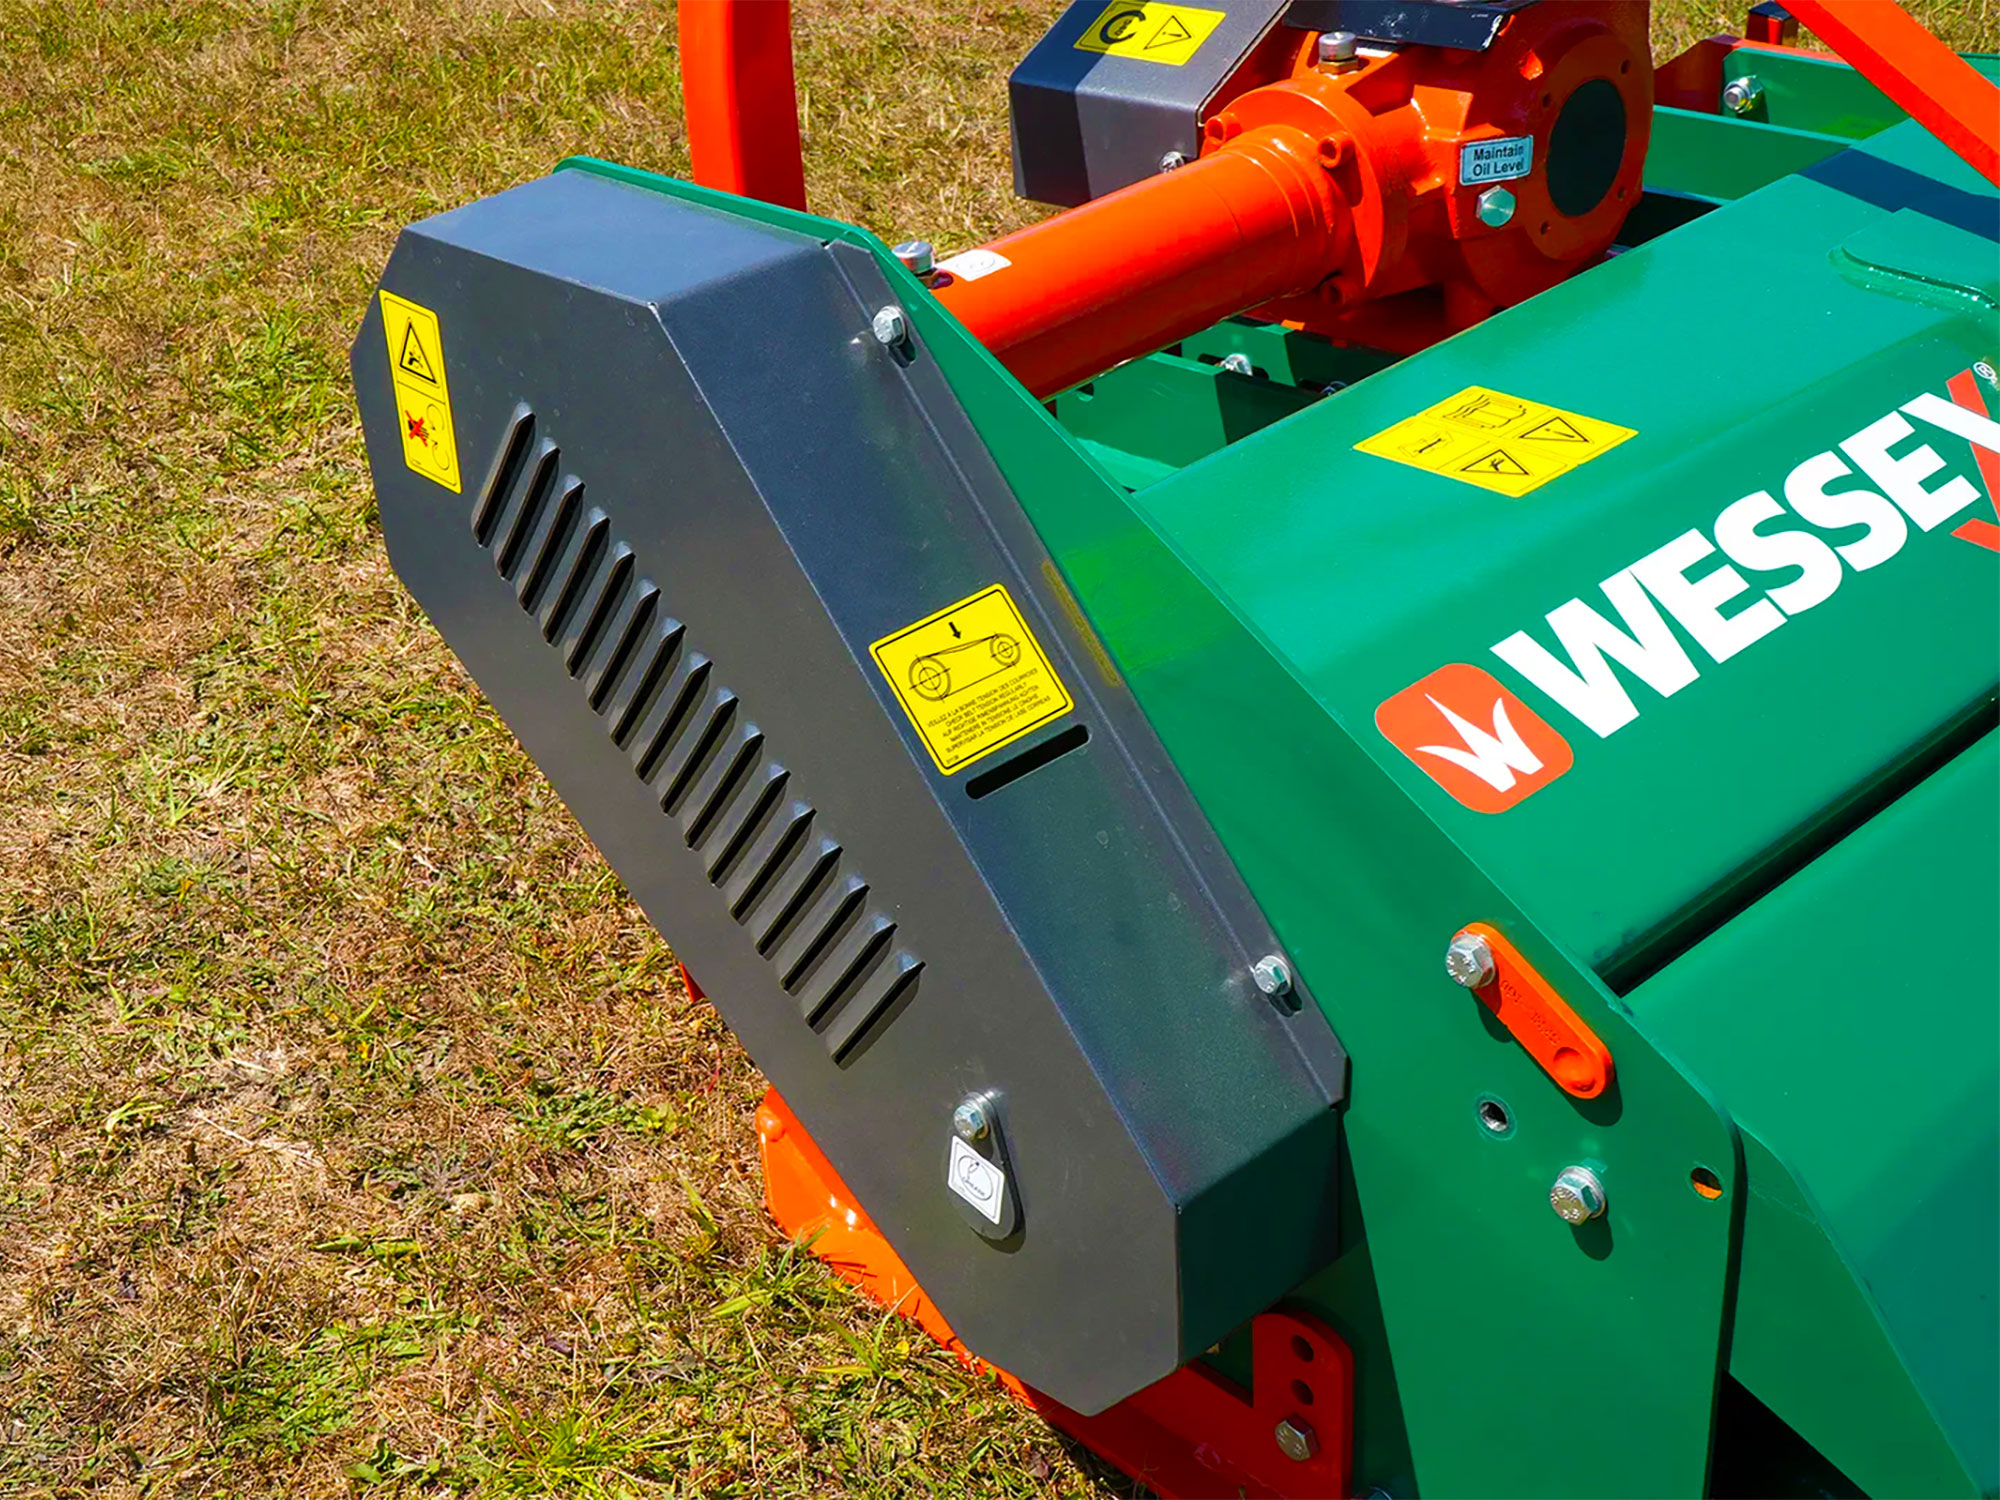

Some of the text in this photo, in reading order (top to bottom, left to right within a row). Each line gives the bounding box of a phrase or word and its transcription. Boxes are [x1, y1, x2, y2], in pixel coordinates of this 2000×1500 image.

[1473, 144, 1524, 160] Maintain
[1473, 157, 1524, 177] Oil Level
